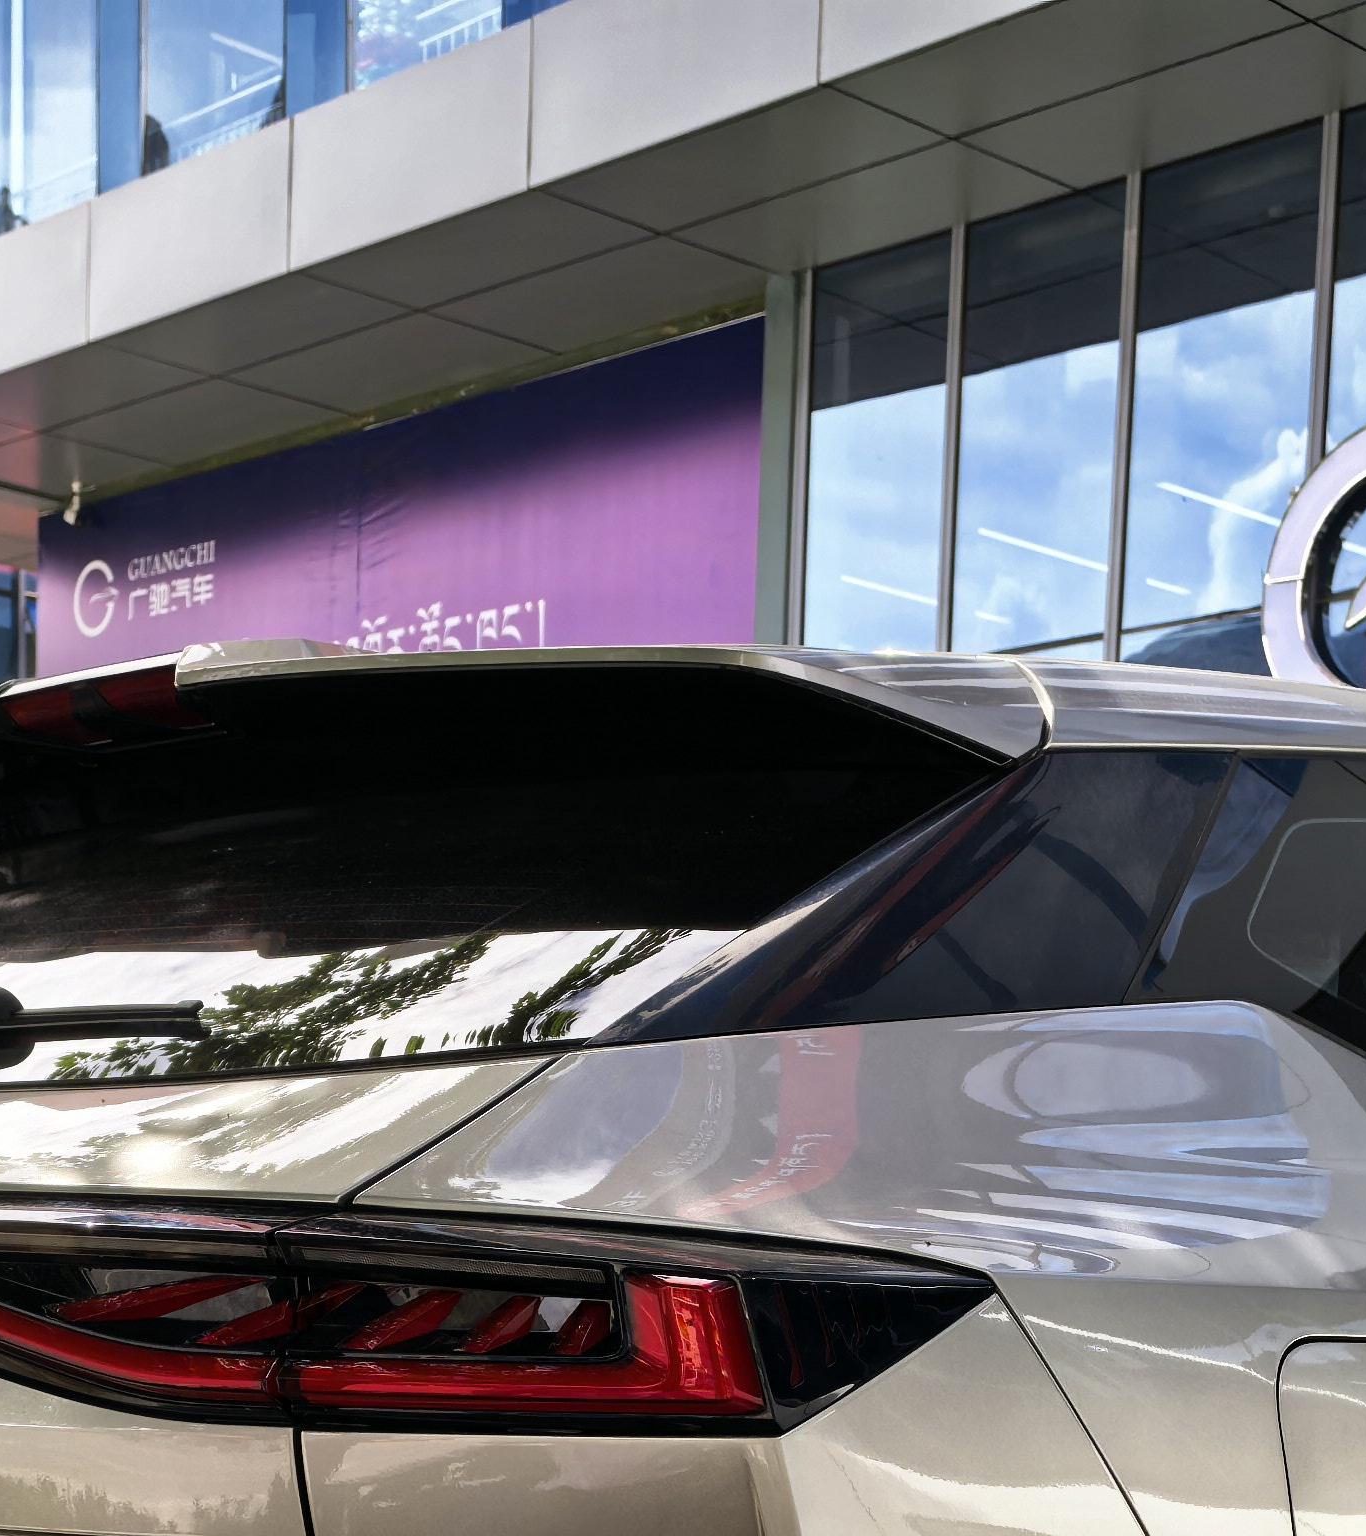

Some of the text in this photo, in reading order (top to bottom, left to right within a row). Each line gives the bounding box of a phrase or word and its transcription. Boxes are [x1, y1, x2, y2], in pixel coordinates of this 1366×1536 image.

[127, 540, 216, 581] GUANGCHI
[127, 574, 215, 621] 广驰汽车
